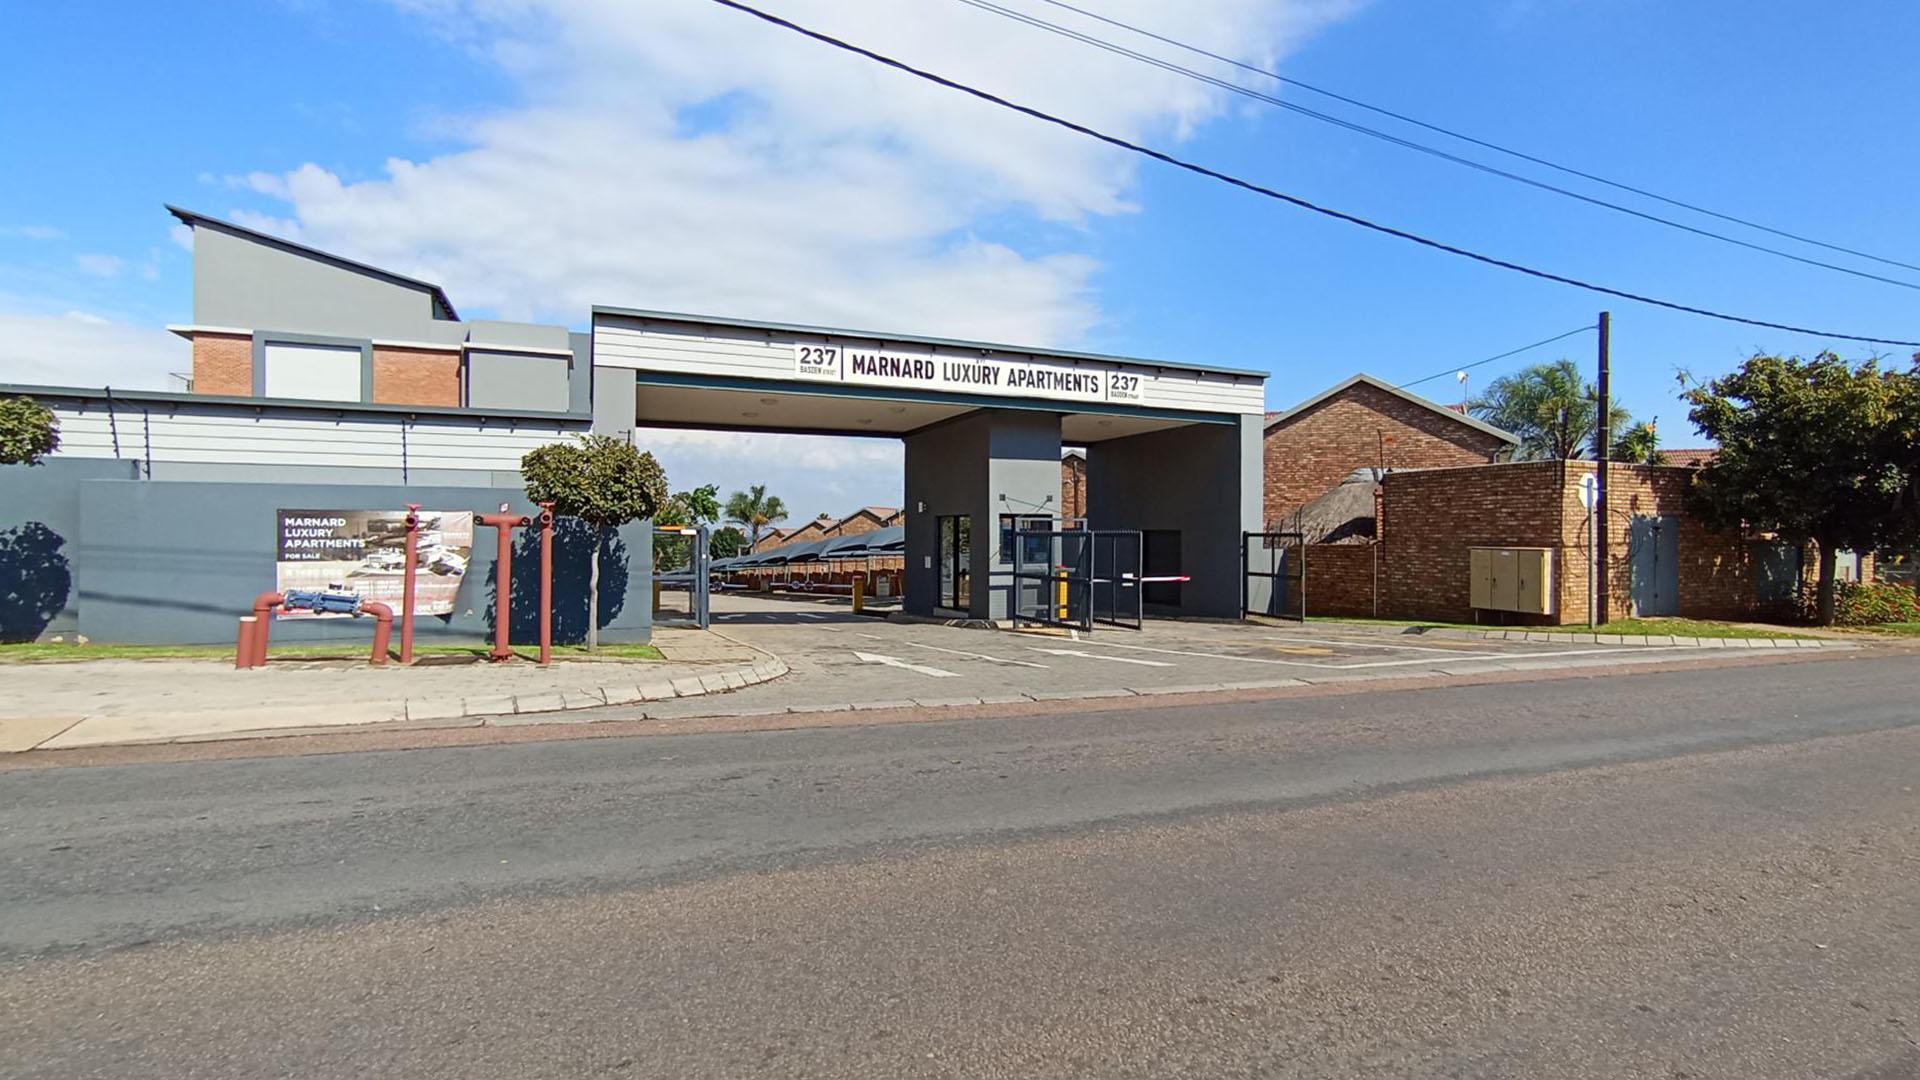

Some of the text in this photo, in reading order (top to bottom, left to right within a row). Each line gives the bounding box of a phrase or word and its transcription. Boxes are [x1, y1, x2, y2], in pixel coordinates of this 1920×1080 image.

[800, 347, 836, 366] 237
[852, 354, 1099, 393] MARNARD LUXURY APARTMENTS
[1111, 375, 1138, 391] 237
[284, 517, 347, 527] MARNARD
[284, 528, 334, 538] LUXURY
[284, 539, 366, 549] APARTMENTS
[285, 552, 321, 560] FOR SALE
